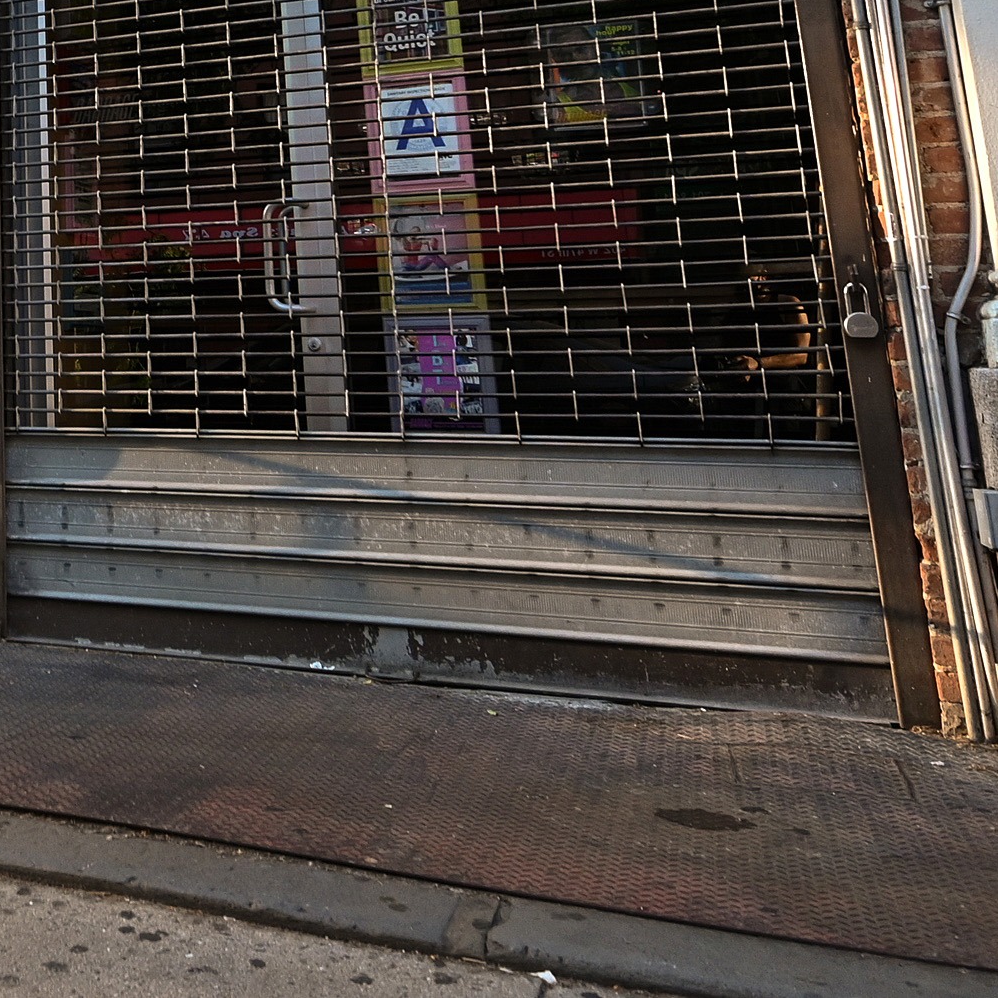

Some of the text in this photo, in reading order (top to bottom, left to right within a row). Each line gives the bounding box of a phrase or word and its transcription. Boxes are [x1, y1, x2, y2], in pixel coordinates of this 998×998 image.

[394, 10, 420, 29] Be
[605, 23, 633, 32] happy
[383, 30, 436, 52] Quiet
[396, 96, 446, 150] A
